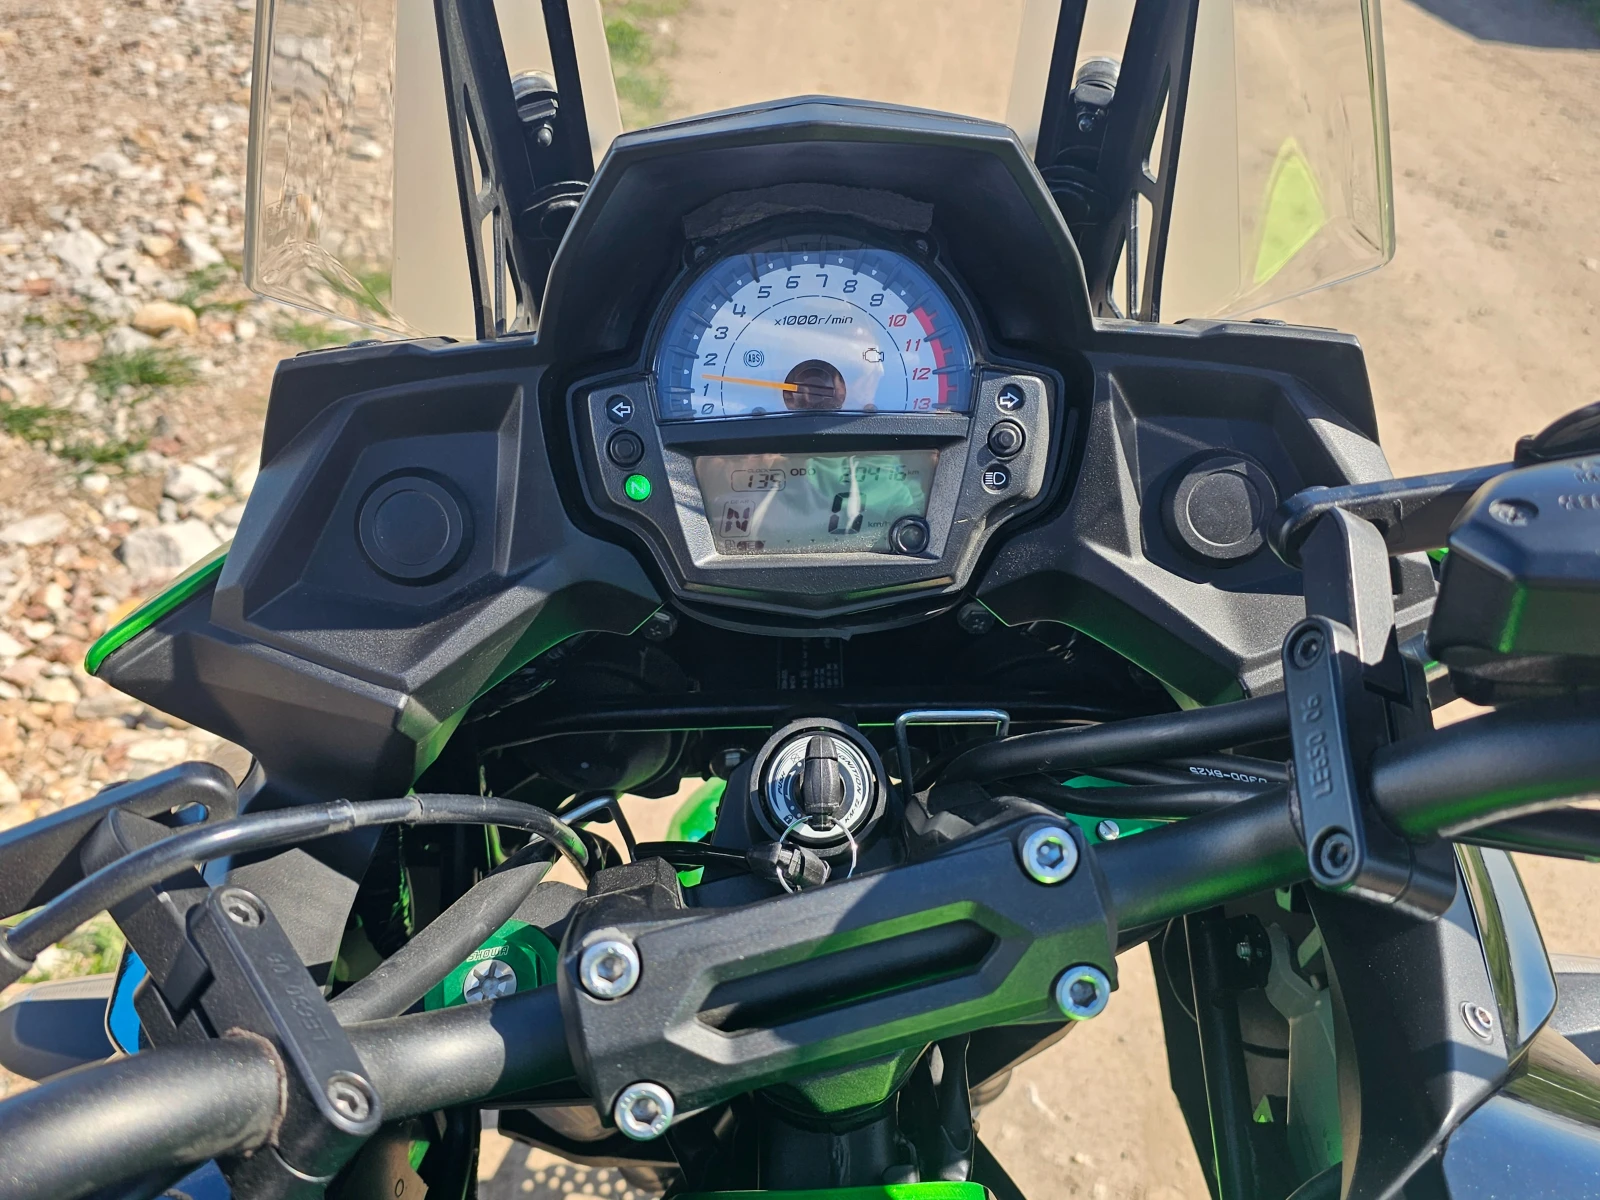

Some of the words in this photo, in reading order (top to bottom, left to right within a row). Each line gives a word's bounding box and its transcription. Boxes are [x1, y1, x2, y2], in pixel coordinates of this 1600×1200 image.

[785, 275, 801, 289] 6
[815, 273, 829, 288] 7
[842, 279, 858, 293] 8
[757, 285, 772, 299] 5
[869, 293, 885, 307] 9
[732, 303, 747, 318] 4
[888, 314, 908, 328] 10
[714, 326, 729, 340] 3
[905, 338, 921, 352] 11
[703, 352, 718, 367] 2
[748, 353, 760, 363] ABS
[912, 367, 931, 381] 12
[703, 383, 710, 397] 1
[701, 403, 715, 415] 0
[912, 398, 931, 410] 13
[790, 468, 816, 476] ODO
[631, 481, 646, 496] N
[725, 507, 750, 533] N
[466, 945, 509, 962] SHOWA
